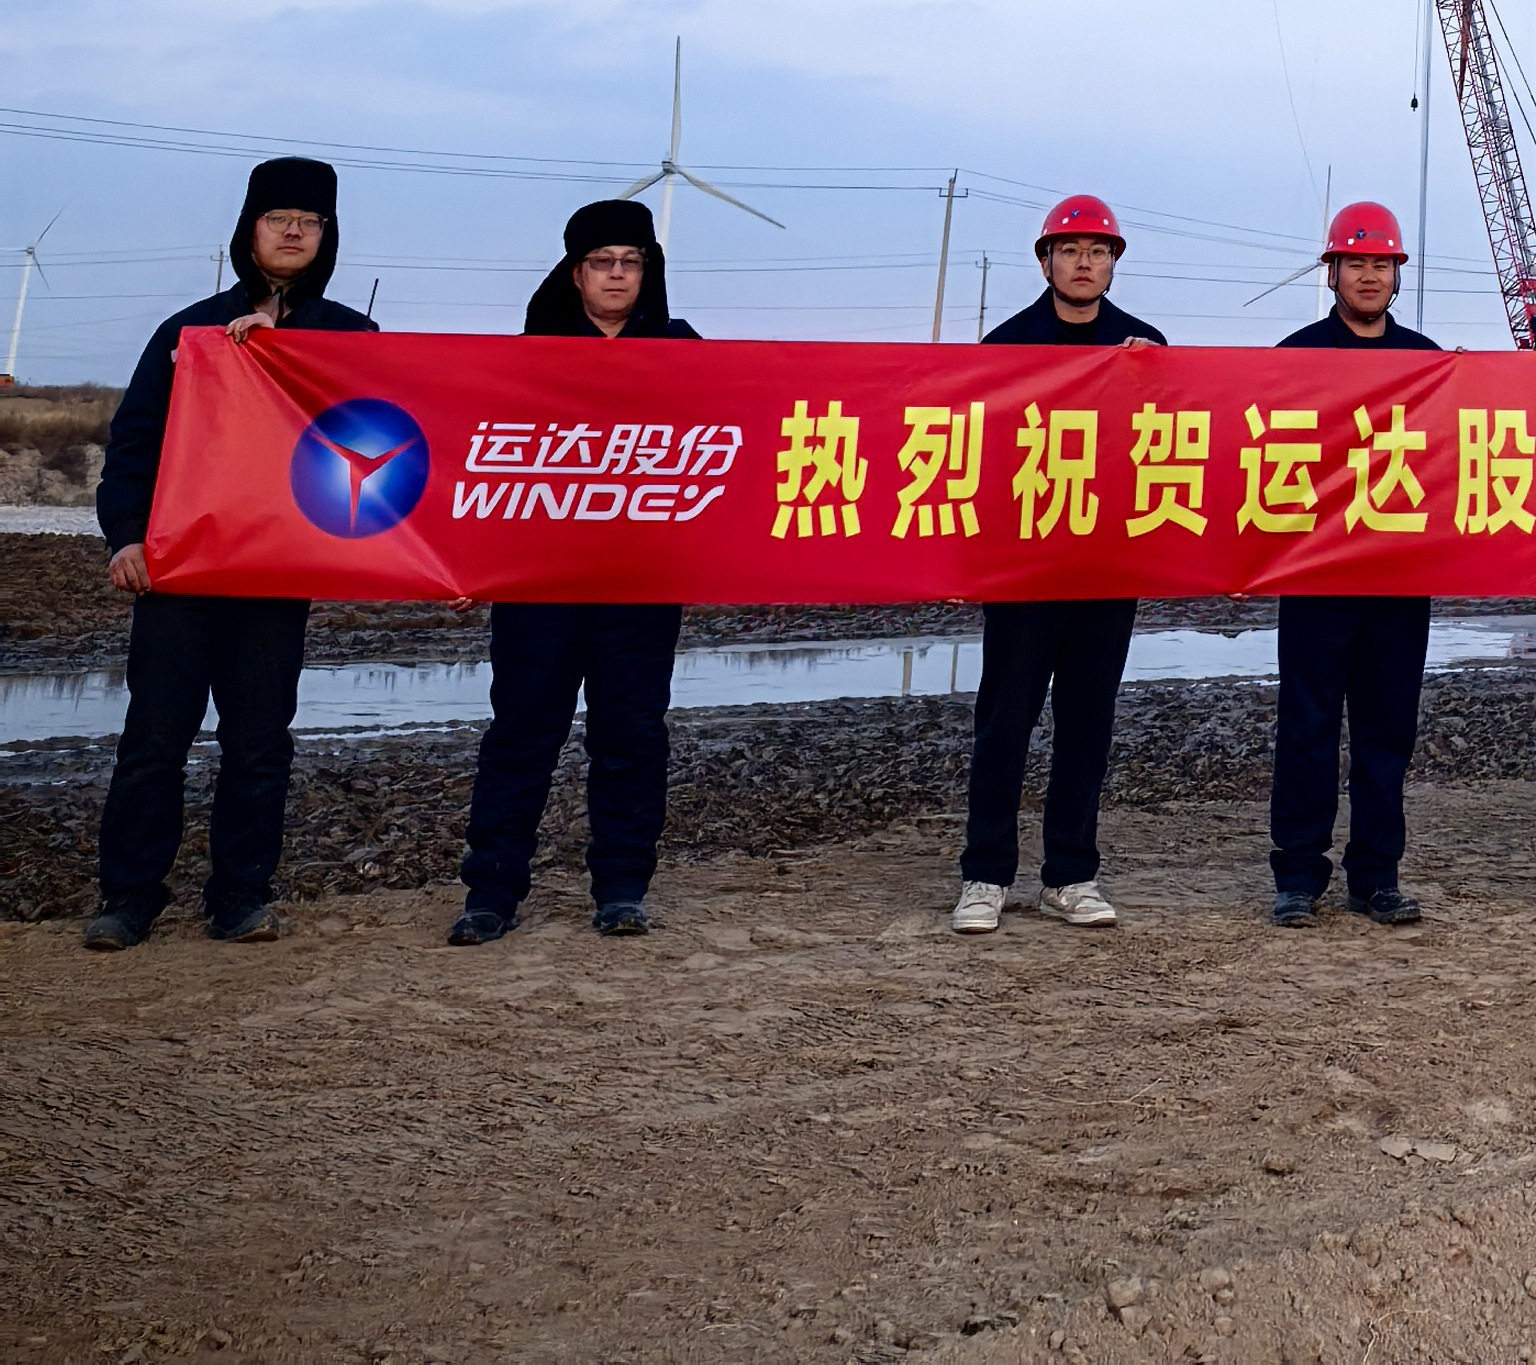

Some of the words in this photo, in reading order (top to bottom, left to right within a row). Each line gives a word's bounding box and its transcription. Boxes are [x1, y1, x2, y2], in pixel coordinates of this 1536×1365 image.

[465, 421, 743, 476] 运达股份
[452, 481, 726, 522] WINDEY
